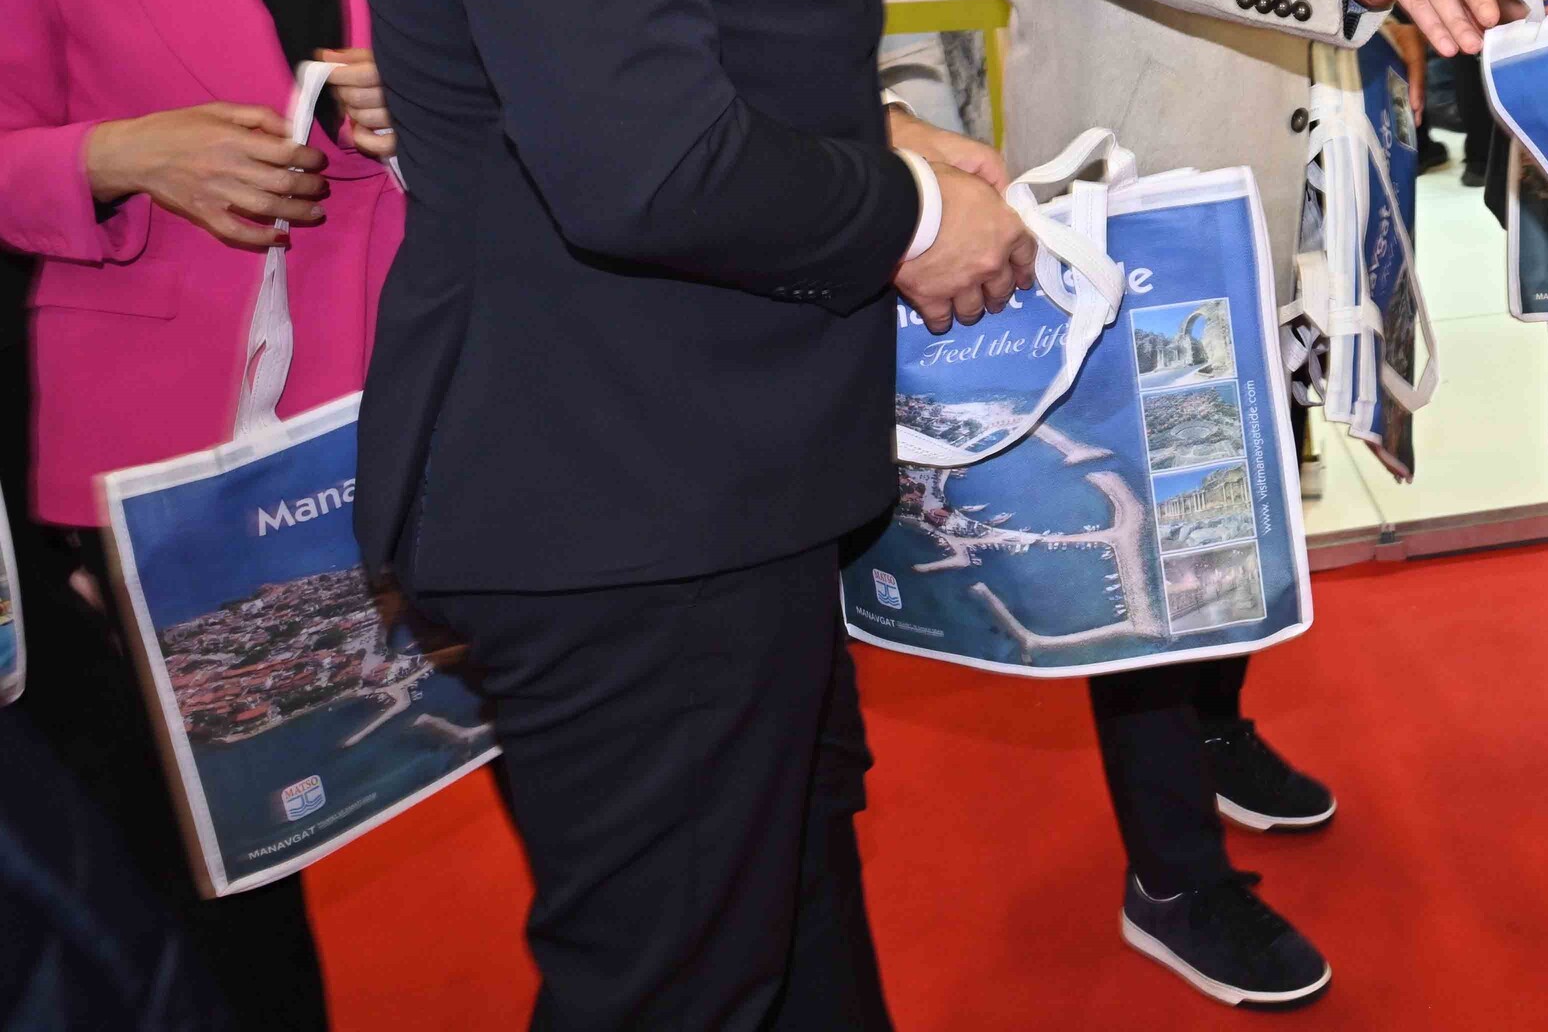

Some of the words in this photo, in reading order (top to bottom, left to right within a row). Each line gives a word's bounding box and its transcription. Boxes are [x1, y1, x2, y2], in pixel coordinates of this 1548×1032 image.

[919, 334, 986, 367] Feel
[988, 330, 1025, 357] the
[1032, 323, 1070, 358] life
[1245, 379, 1269, 502] visitmanavgatside.com
[855, 606, 896, 628] MANAVGAT
[284, 776, 320, 800] MATSO
[249, 825, 317, 861] MANAVGAT
